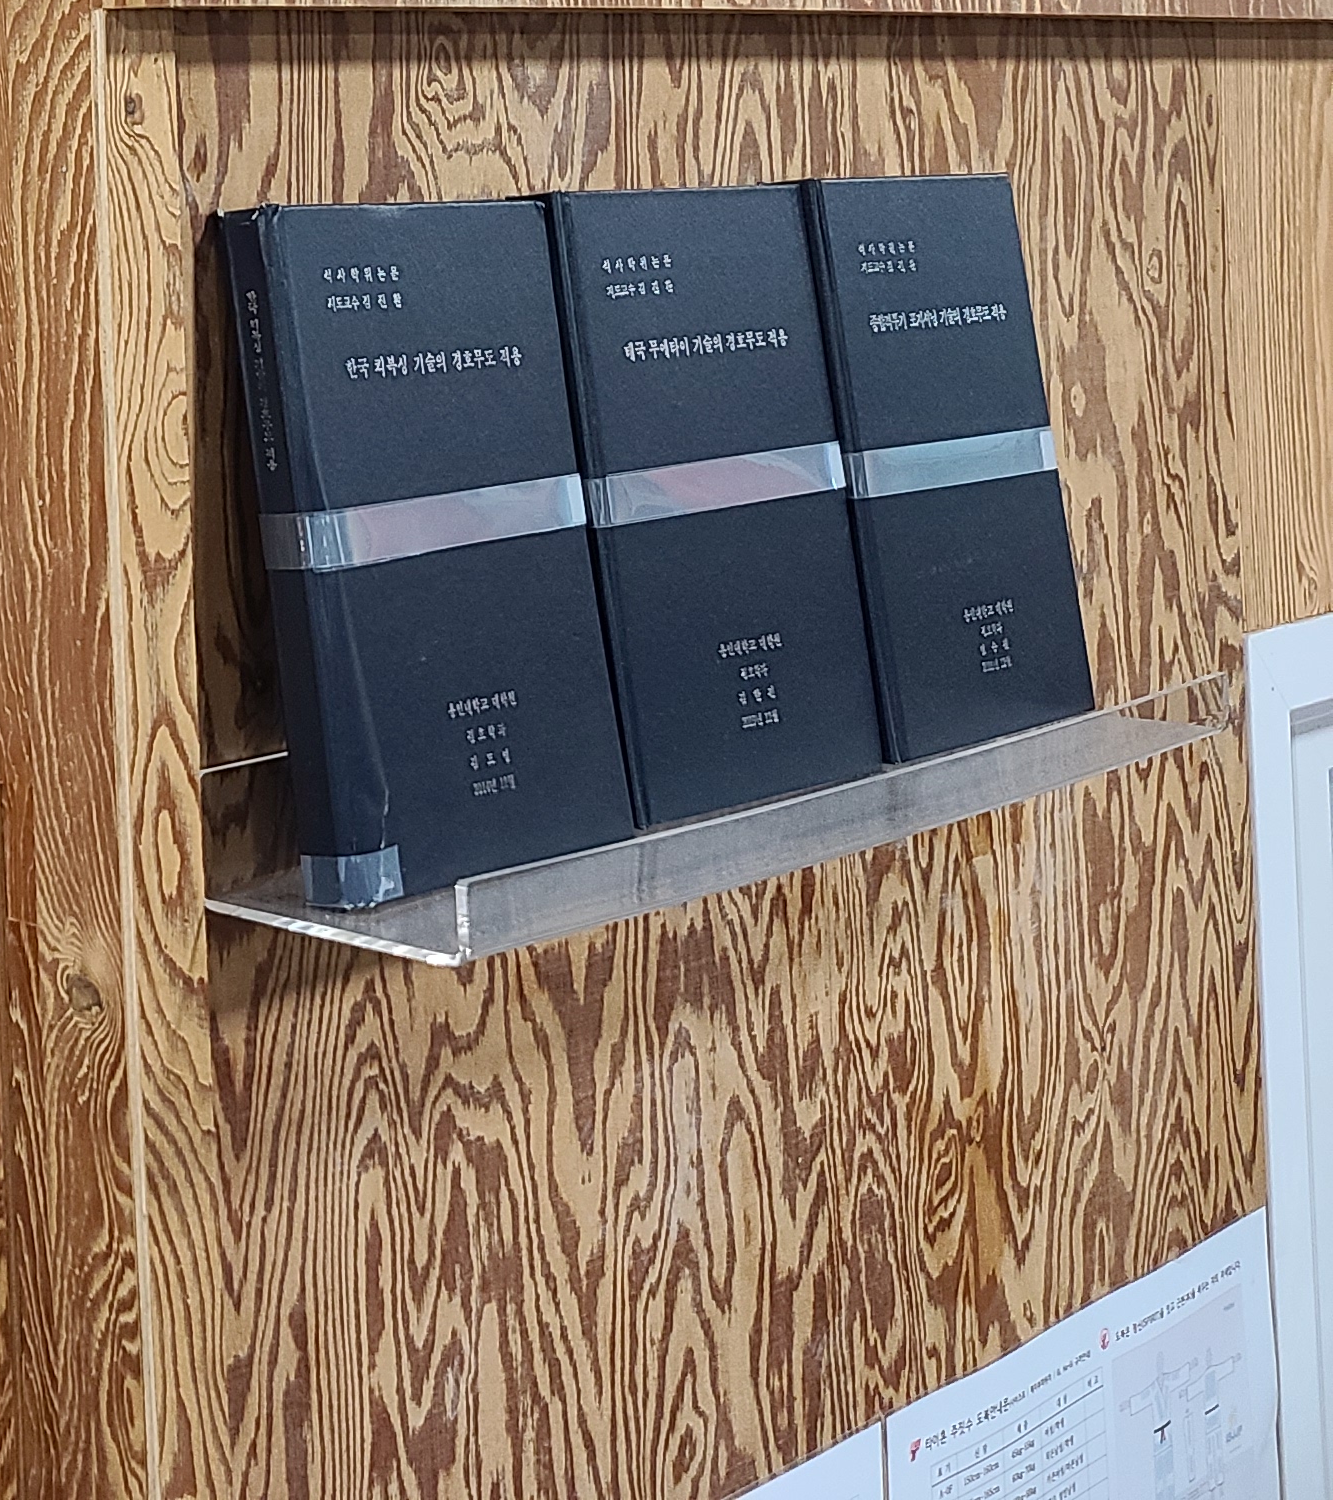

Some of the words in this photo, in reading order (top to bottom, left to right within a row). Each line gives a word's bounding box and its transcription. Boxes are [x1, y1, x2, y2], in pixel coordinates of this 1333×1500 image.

[691, 333, 723, 355] 기술의
[725, 330, 766, 351] 경호무도
[345, 357, 369, 379] 한국
[413, 351, 447, 374] 기술의
[451, 348, 496, 371] 경호무도
